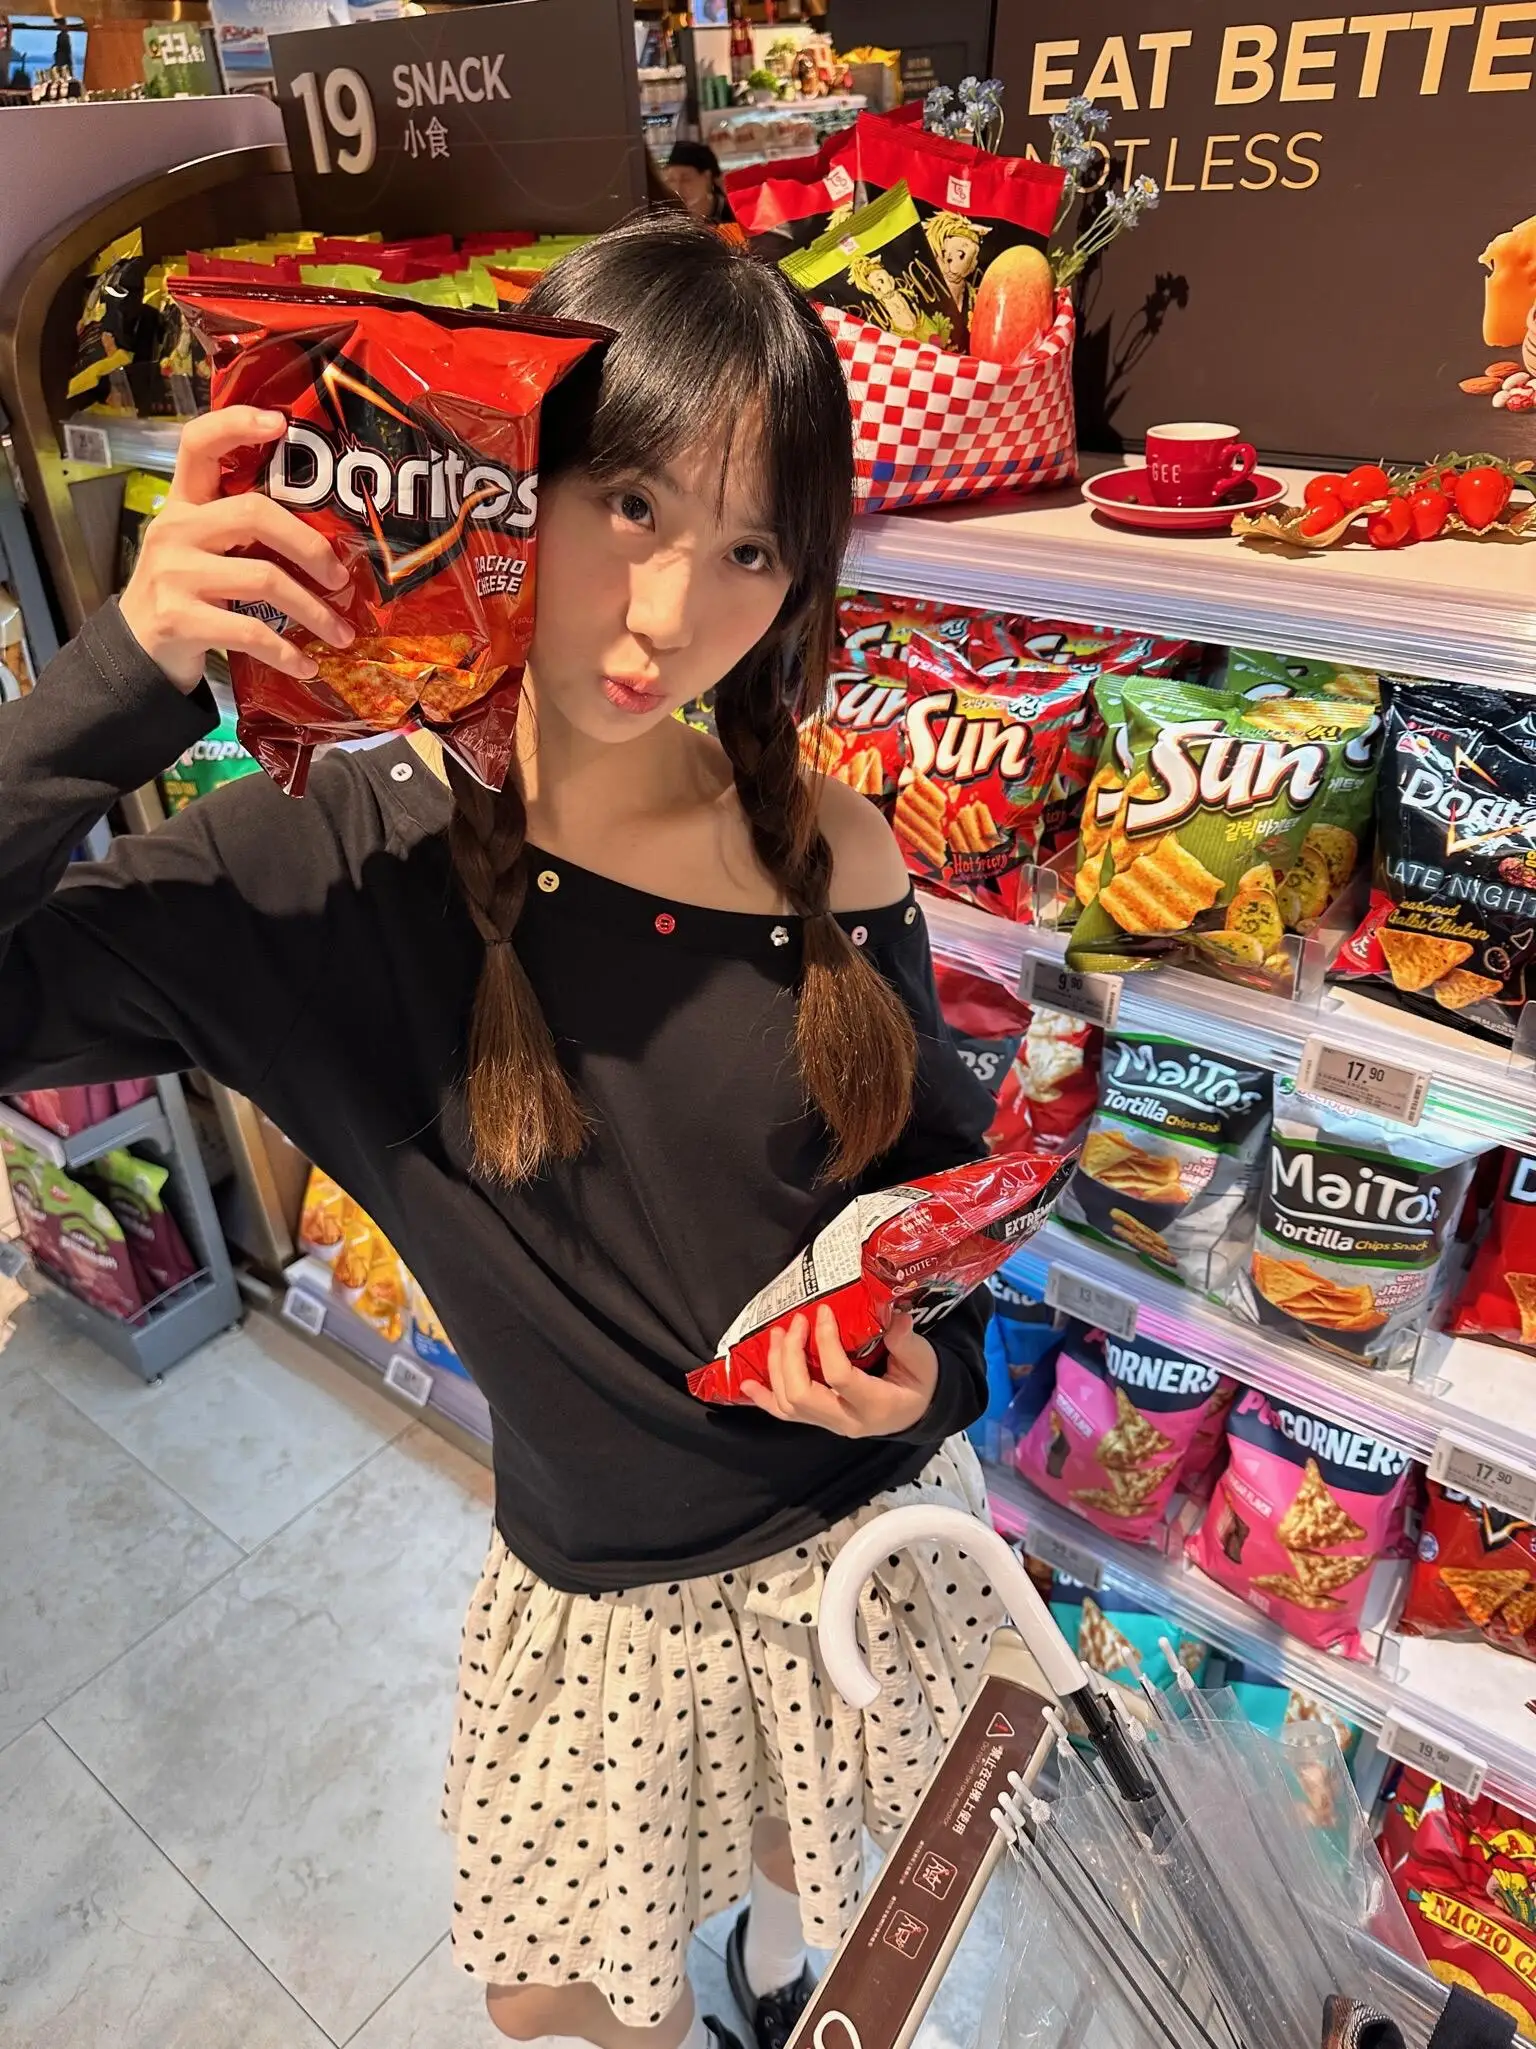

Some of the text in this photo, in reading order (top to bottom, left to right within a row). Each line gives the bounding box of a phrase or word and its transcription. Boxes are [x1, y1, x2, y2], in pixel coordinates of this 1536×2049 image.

[1028, 2, 1536, 115] EAT BETTE
[393, 54, 512, 109] SNACK
[290, 68, 377, 175] 19
[403, 116, 450, 159] 小食
[1164, 131, 1323, 192] LESS
[269, 425, 539, 529] Doritos
[474, 555, 527, 575] NACHO
[476, 575, 522, 597] CHEESE
[899, 689, 1028, 786] Sun
[1126, 719, 1326, 836] Sun
[1387, 856, 1443, 890] LATE
[1388, 908, 1491, 941] Galbi Chicken
[1347, 1061, 1385, 1084] 17.90
[1104, 1087, 1168, 1123] Tortilla
[1166, 1113, 1198, 1129] Chips
[1275, 1211, 1355, 1251] Tortilla
[1354, 1239, 1391, 1252] Chips
[905, 1257, 932, 1277] LOTTE
[1476, 1463, 1513, 1485] 17.90
[1432, 1896, 1512, 1957] NACHO
